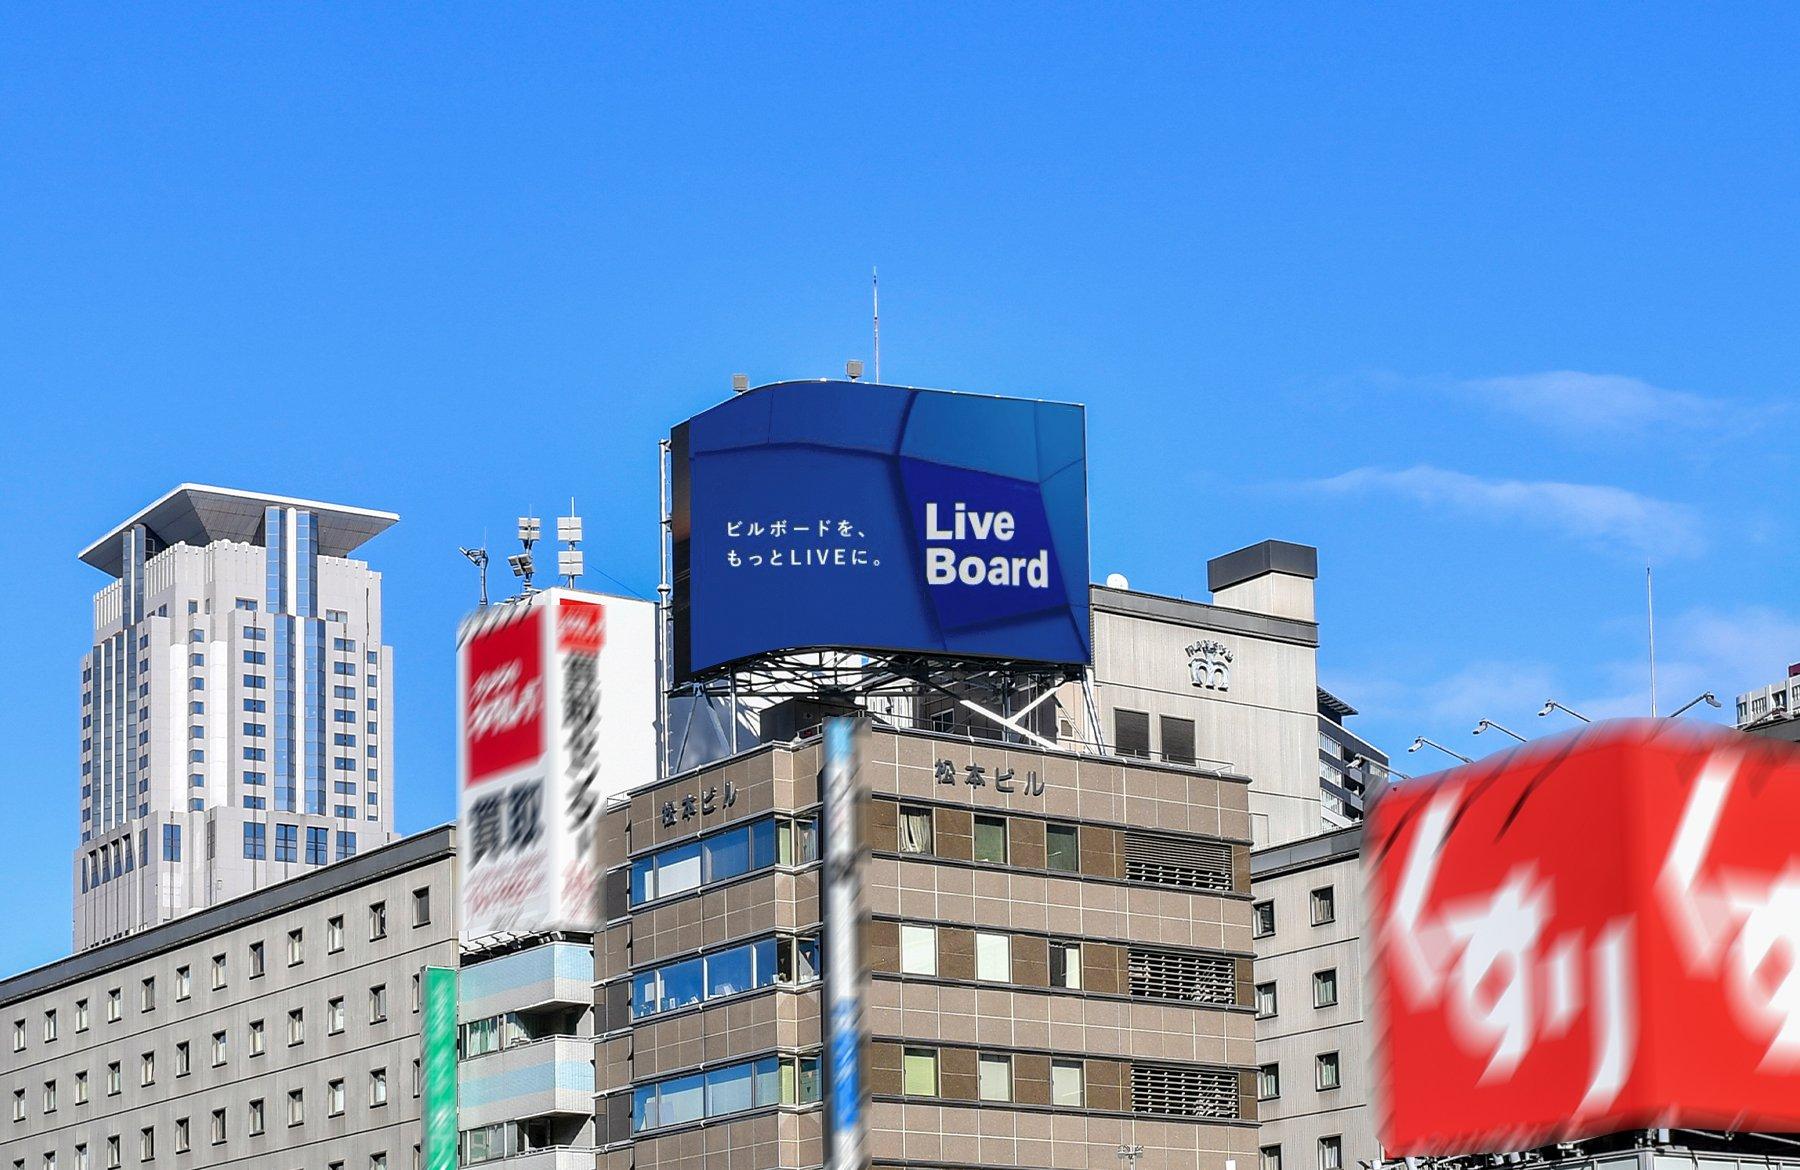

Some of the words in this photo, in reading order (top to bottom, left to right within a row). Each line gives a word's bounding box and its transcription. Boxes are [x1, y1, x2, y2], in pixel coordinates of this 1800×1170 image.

[727, 519, 865, 538] ビルボードを、
[926, 502, 1015, 541] Live
[727, 549, 880, 567] もっとLIVEに。
[926, 547, 1049, 589] Board
[935, 758, 1045, 796] 松本ビル
[661, 781, 740, 829] 松本ビル
